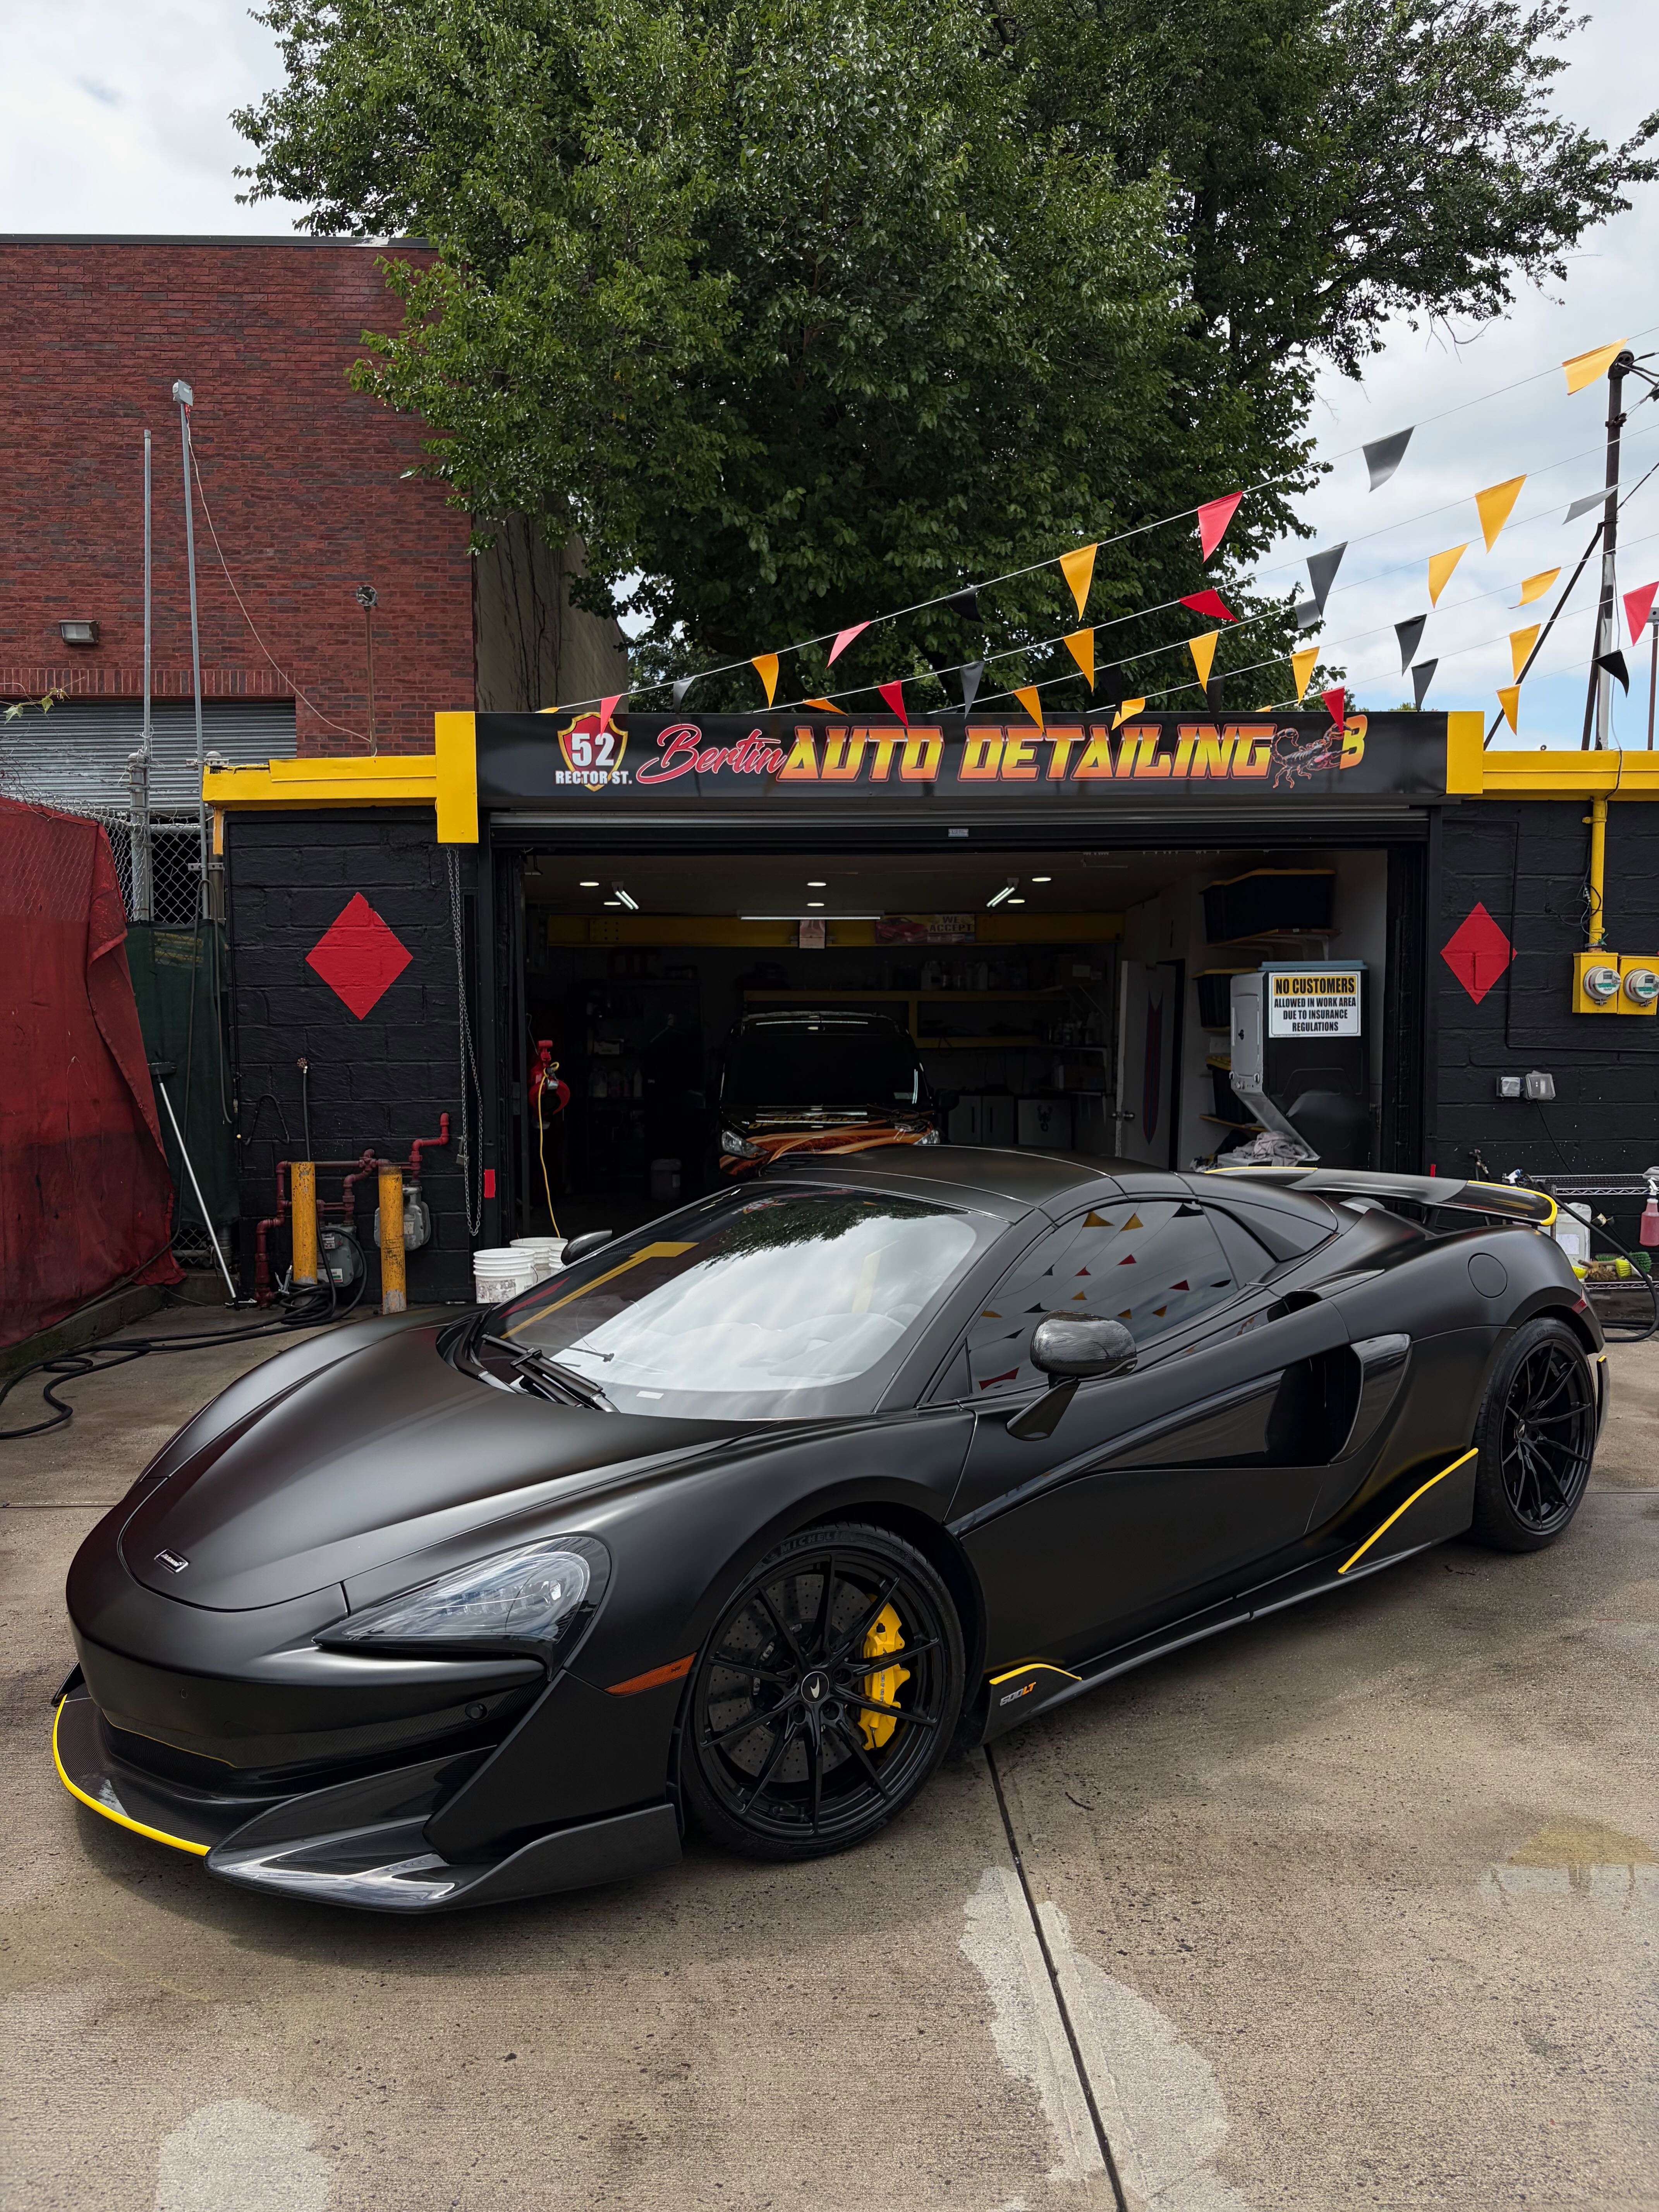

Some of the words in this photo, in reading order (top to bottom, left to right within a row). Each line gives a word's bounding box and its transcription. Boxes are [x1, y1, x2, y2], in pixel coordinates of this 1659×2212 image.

[572, 732, 615, 766] 52
[636, 724, 788, 784] Bertin
[776, 725, 944, 782] AUTO
[958, 724, 1278, 781] DETAILING
[556, 771, 608, 784] RECTOR
[611, 771, 632, 784] ST.
[1276, 978, 1289, 994] NO
[1292, 977, 1355, 994] CUSTOMERS
[1274, 998, 1305, 1008] ALLOWED
[1308, 998, 1314, 1007] IN
[1316, 998, 1337, 1007] WORK
[1339, 997, 1356, 1006] AREA
[1283, 1010, 1297, 1020] DUE
[1298, 1010, 1307, 1019] TO
[1309, 1009, 1348, 1019] INSURANCE
[1292, 1022, 1339, 1032] REGULATIONS
[1000, 1681, 1036, 1706] 600LT
